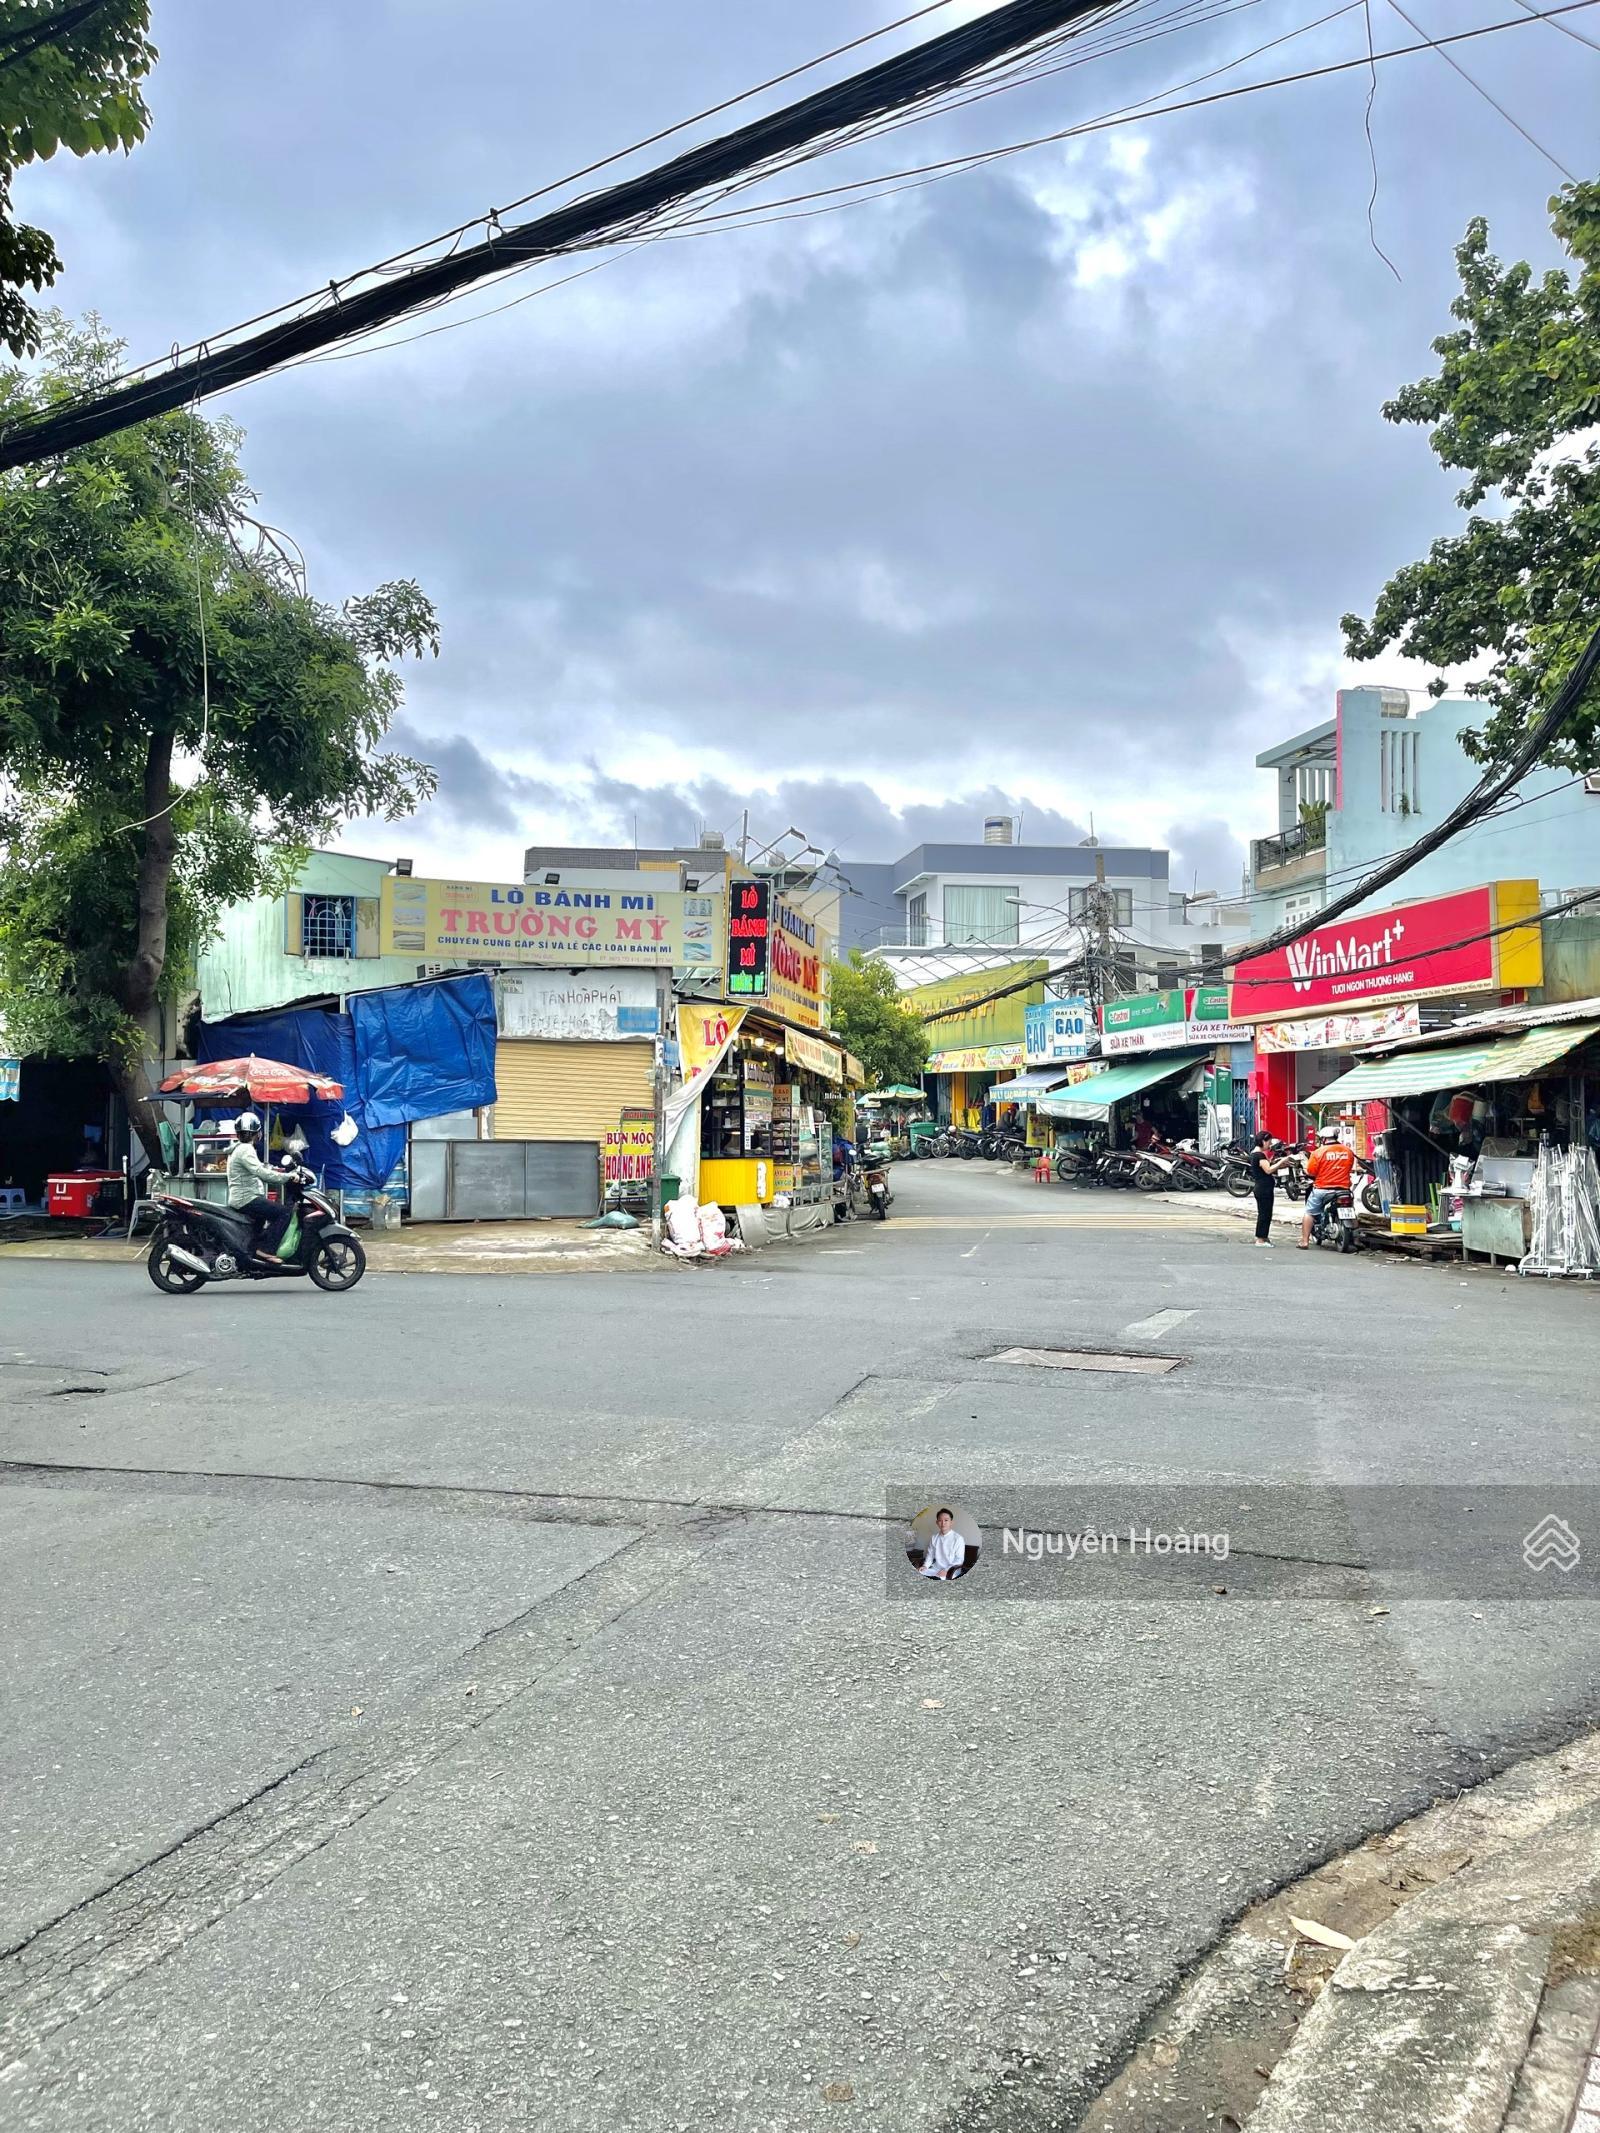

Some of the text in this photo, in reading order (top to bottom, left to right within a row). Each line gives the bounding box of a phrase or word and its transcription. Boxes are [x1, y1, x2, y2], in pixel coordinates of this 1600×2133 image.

[491, 887, 525, 904] LÒ
[535, 889, 611, 909] BÁNH
[621, 894, 654, 911] MÌ
[741, 885, 758, 909] LÒ
[439, 907, 671, 941] TRƯỜNG MỸ
[731, 914, 767, 938] BÁNH
[483, 938, 511, 947] CUNG
[1209, 996, 1229, 1004] Castro
[703, 1012, 730, 1047] LÒ
[1210, 1023, 1222, 1031] XE
[1121, 1036, 1129, 1048] XE
